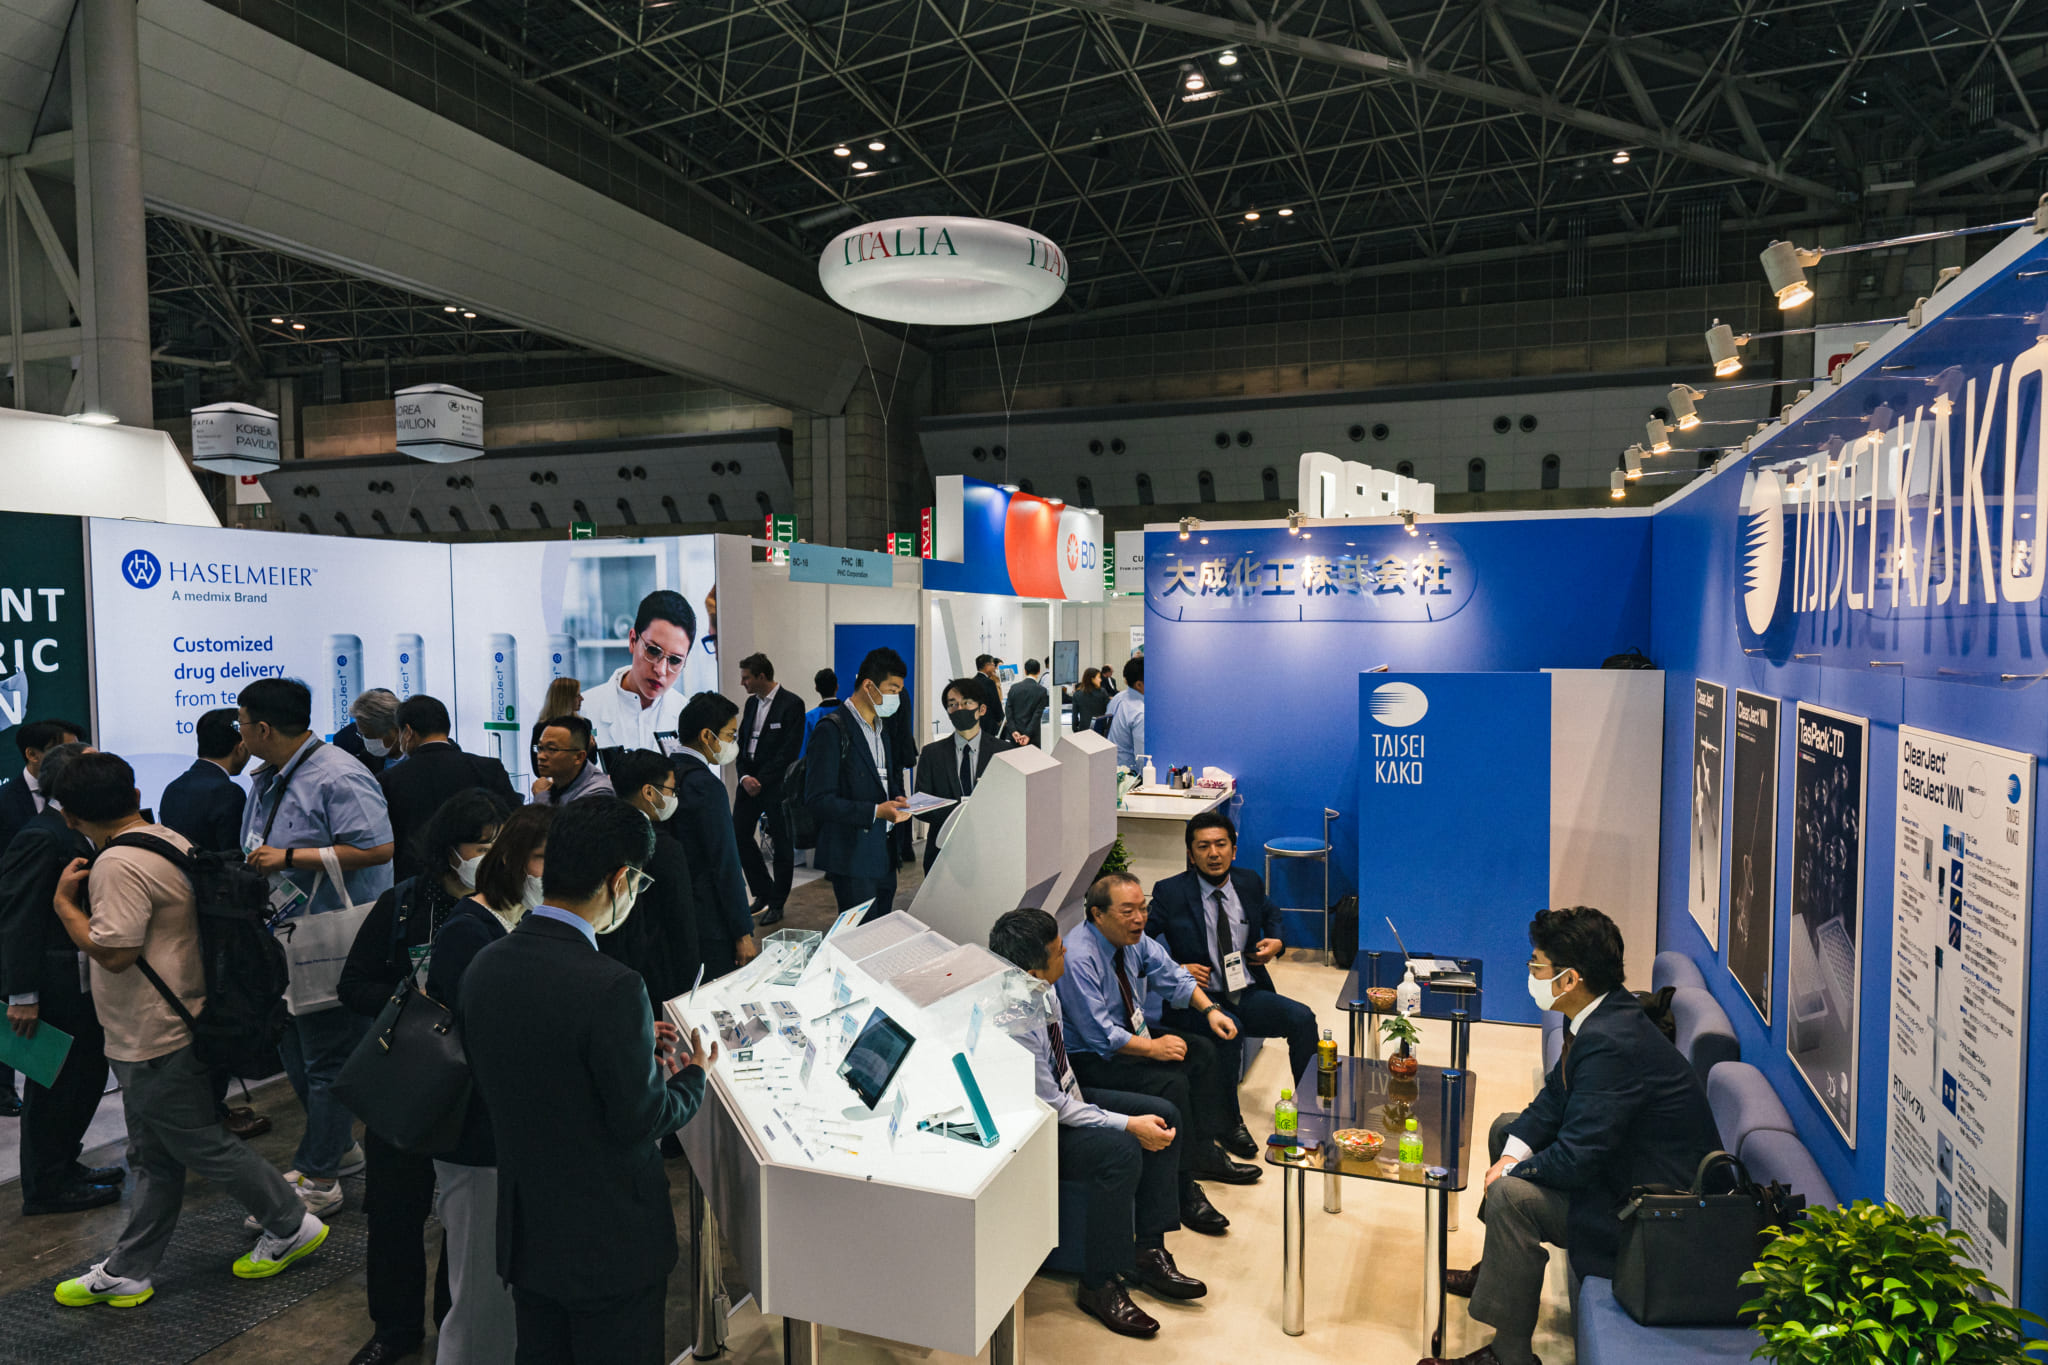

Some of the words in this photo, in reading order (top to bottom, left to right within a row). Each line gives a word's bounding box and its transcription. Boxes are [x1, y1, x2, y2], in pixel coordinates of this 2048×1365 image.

[844, 227, 959, 266] ITALIA
[236, 424, 272, 436] KOREA
[1890, 335, 2048, 608] KAKO
[1792, 428, 1880, 613] TAISEI
[841, 557, 853, 567] PHC
[1081, 541, 1096, 570] BD
[1103, 547, 1114, 590] ITALI
[1164, 553, 1447, 588] 大成化工株式会社
[172, 590, 181, 600] A
[184, 592, 231, 602] medmix
[234, 592, 268, 603] Brand
[173, 635, 273, 653] Customized
[174, 663, 215, 684] drug
[220, 661, 285, 679] delivery
[175, 690, 216, 707] from
[176, 720, 194, 734] to
[1371, 733, 1425, 758] TAISEI
[1903, 740, 1946, 775] ClearJect
[1375, 760, 1423, 785] KAKO
[1902, 768, 1945, 806] ClearJect
[1947, 783, 1964, 813] WN
